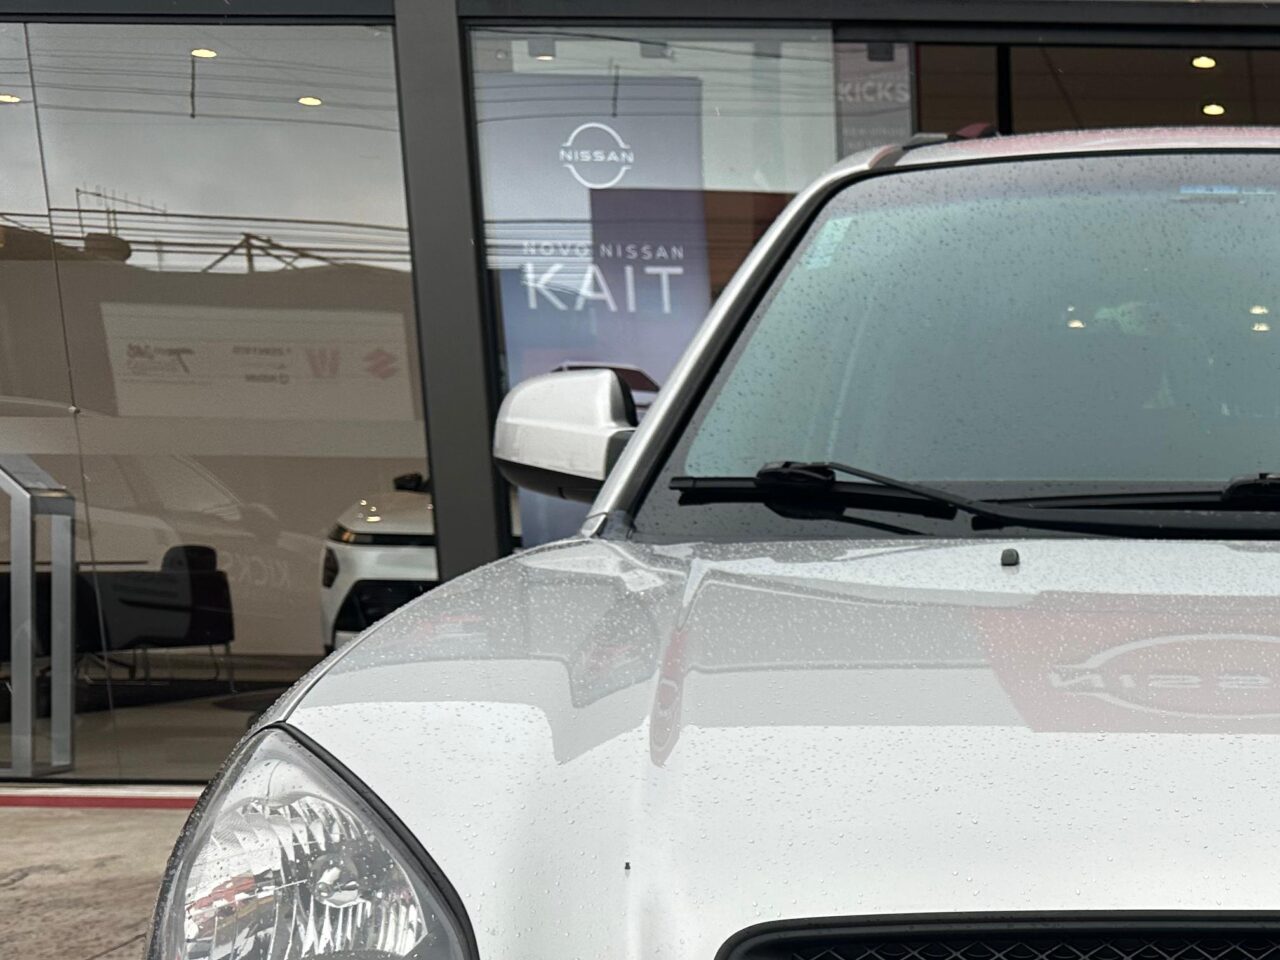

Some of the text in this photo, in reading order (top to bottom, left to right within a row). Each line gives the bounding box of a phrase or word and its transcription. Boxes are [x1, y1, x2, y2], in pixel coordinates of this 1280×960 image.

[838, 82, 911, 102] KICKS
[559, 149, 634, 163] NISSAN
[523, 242, 685, 260] NOVO NISSAN
[525, 262, 684, 314] KAIT
